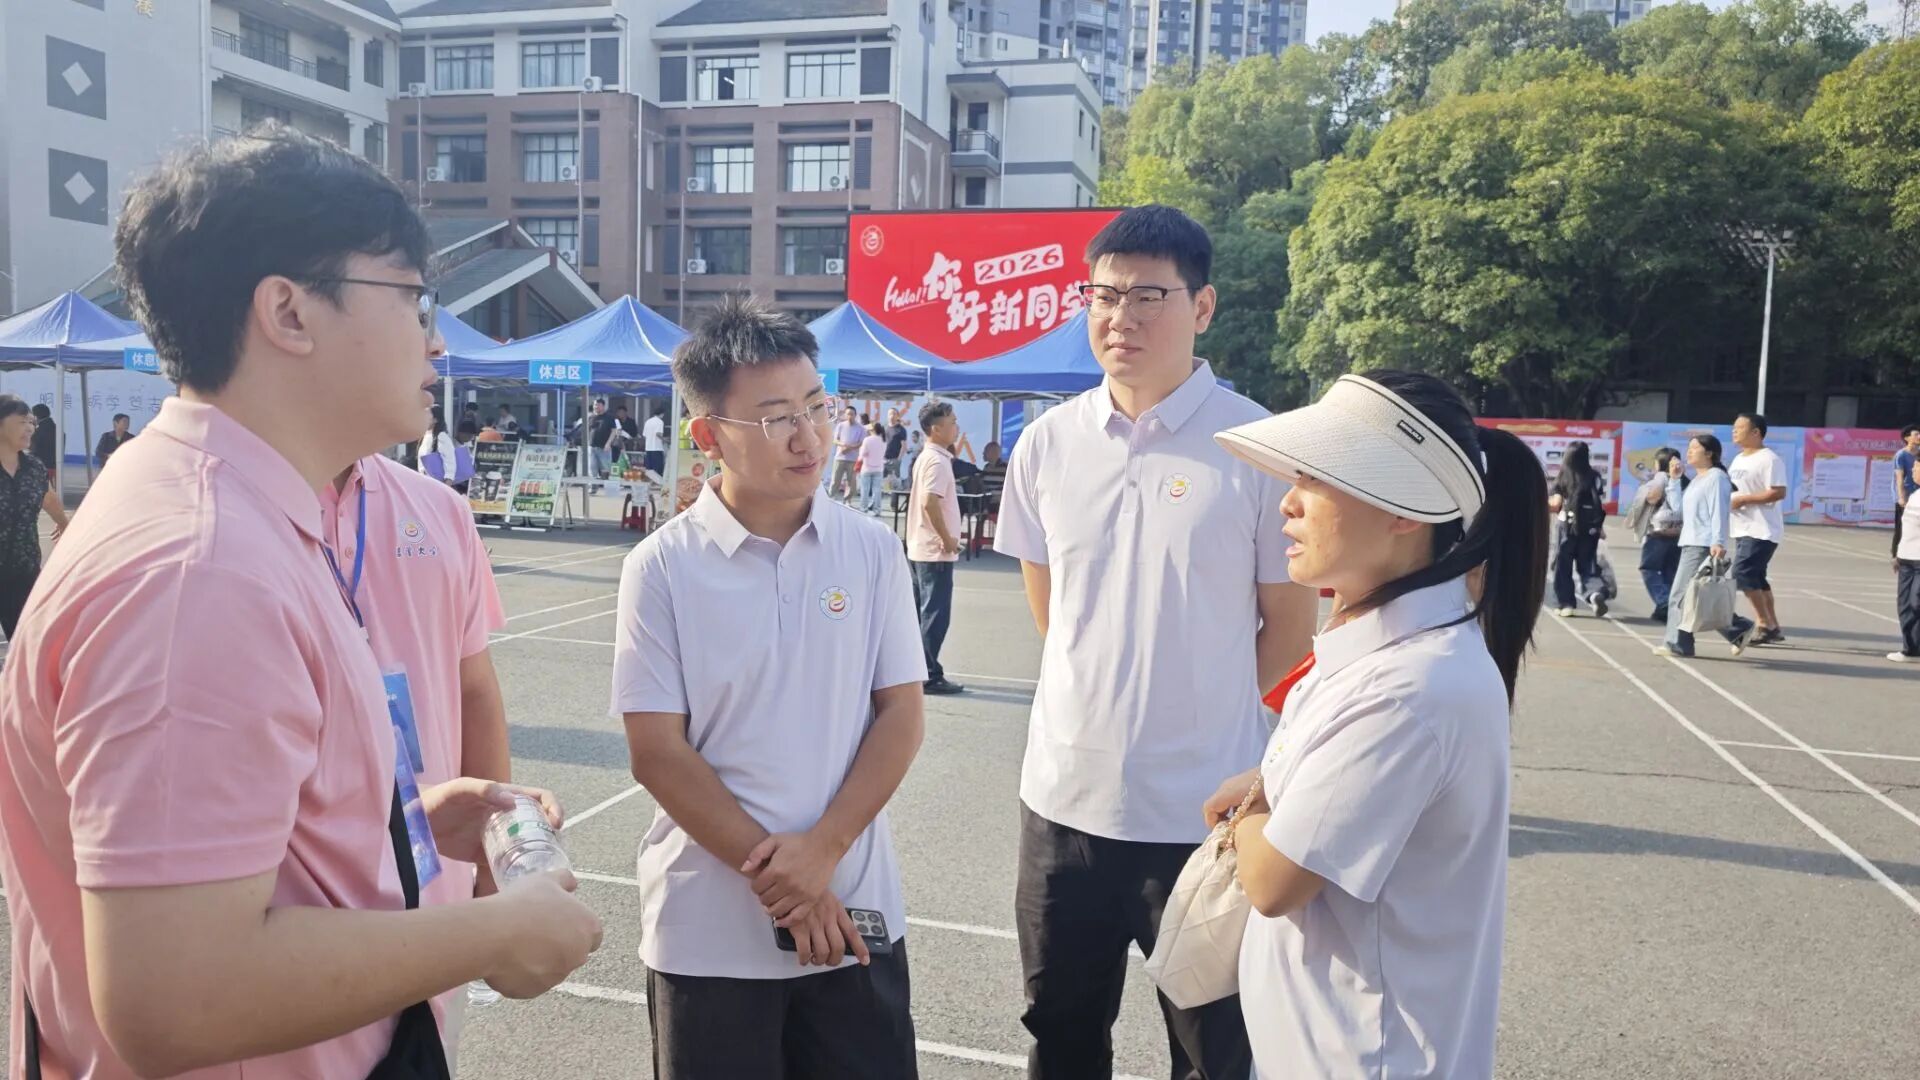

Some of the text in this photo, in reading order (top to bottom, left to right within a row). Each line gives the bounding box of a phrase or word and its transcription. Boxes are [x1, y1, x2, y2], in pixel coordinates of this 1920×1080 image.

[977, 247, 1061, 281] 2026
[132, 351, 160, 368] 休息
[538, 364, 582, 380] 休息区
